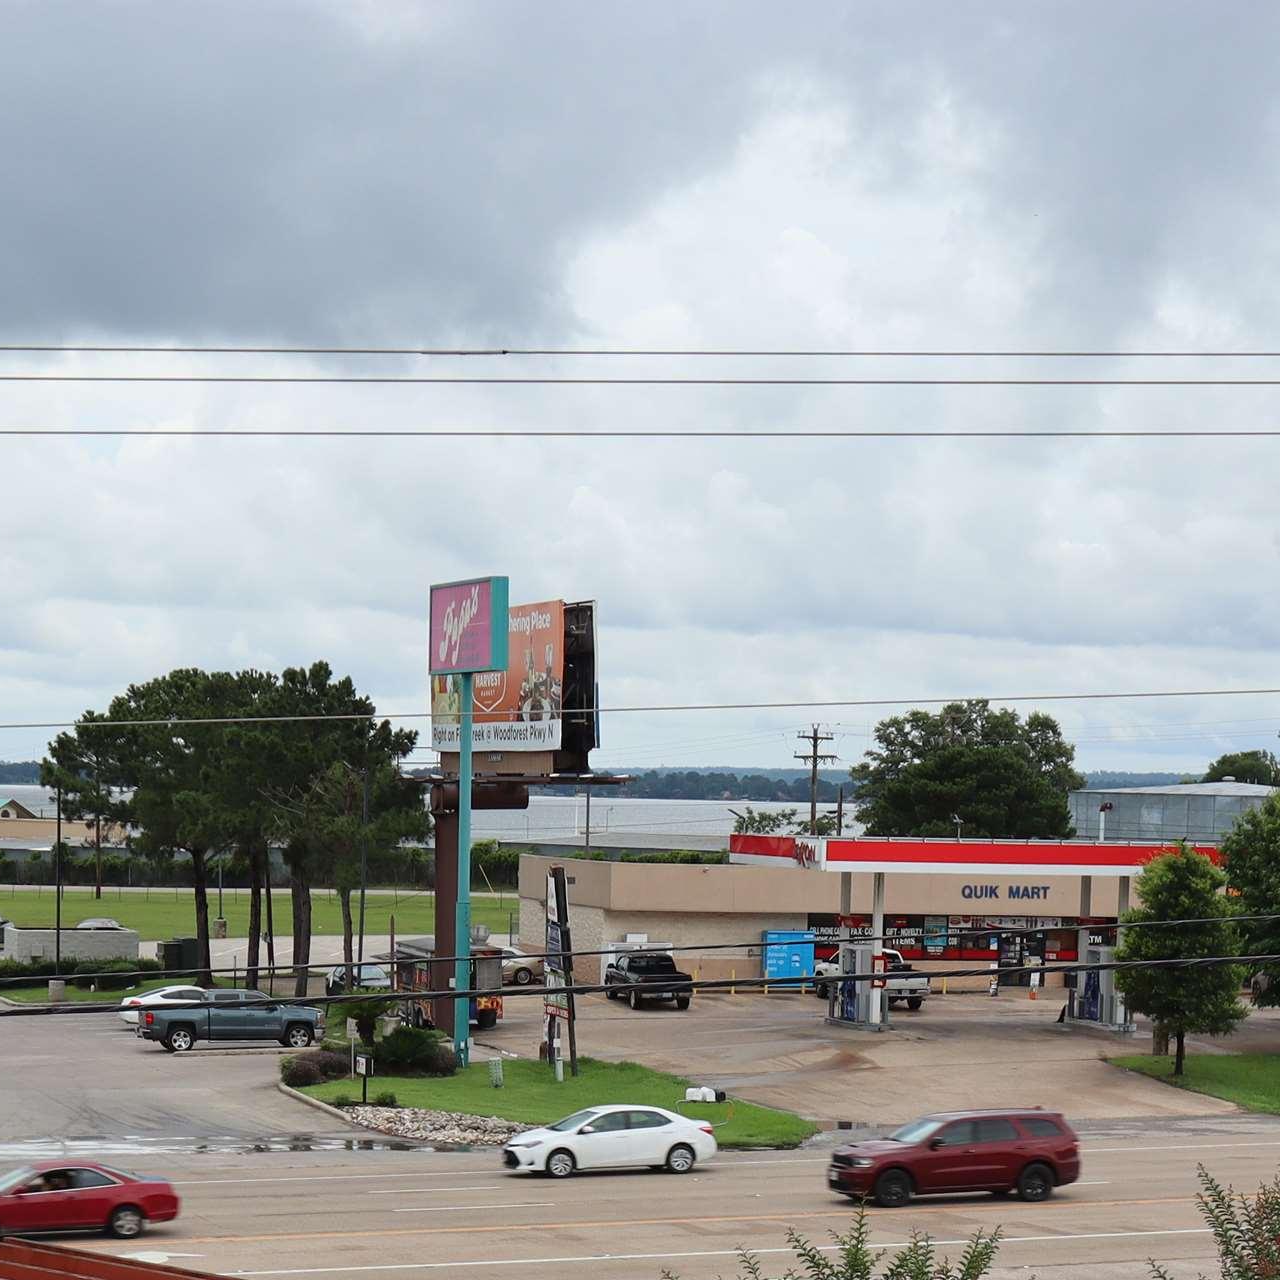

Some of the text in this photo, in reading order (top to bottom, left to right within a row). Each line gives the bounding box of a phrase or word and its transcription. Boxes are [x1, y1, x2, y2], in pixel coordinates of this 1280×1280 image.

[531, 610, 551, 630] Place
[433, 726, 447, 744] Right
[493, 724, 528, 741] Woodforest
[548, 723, 554, 739] N
[961, 884, 1050, 900] QUIK MART
